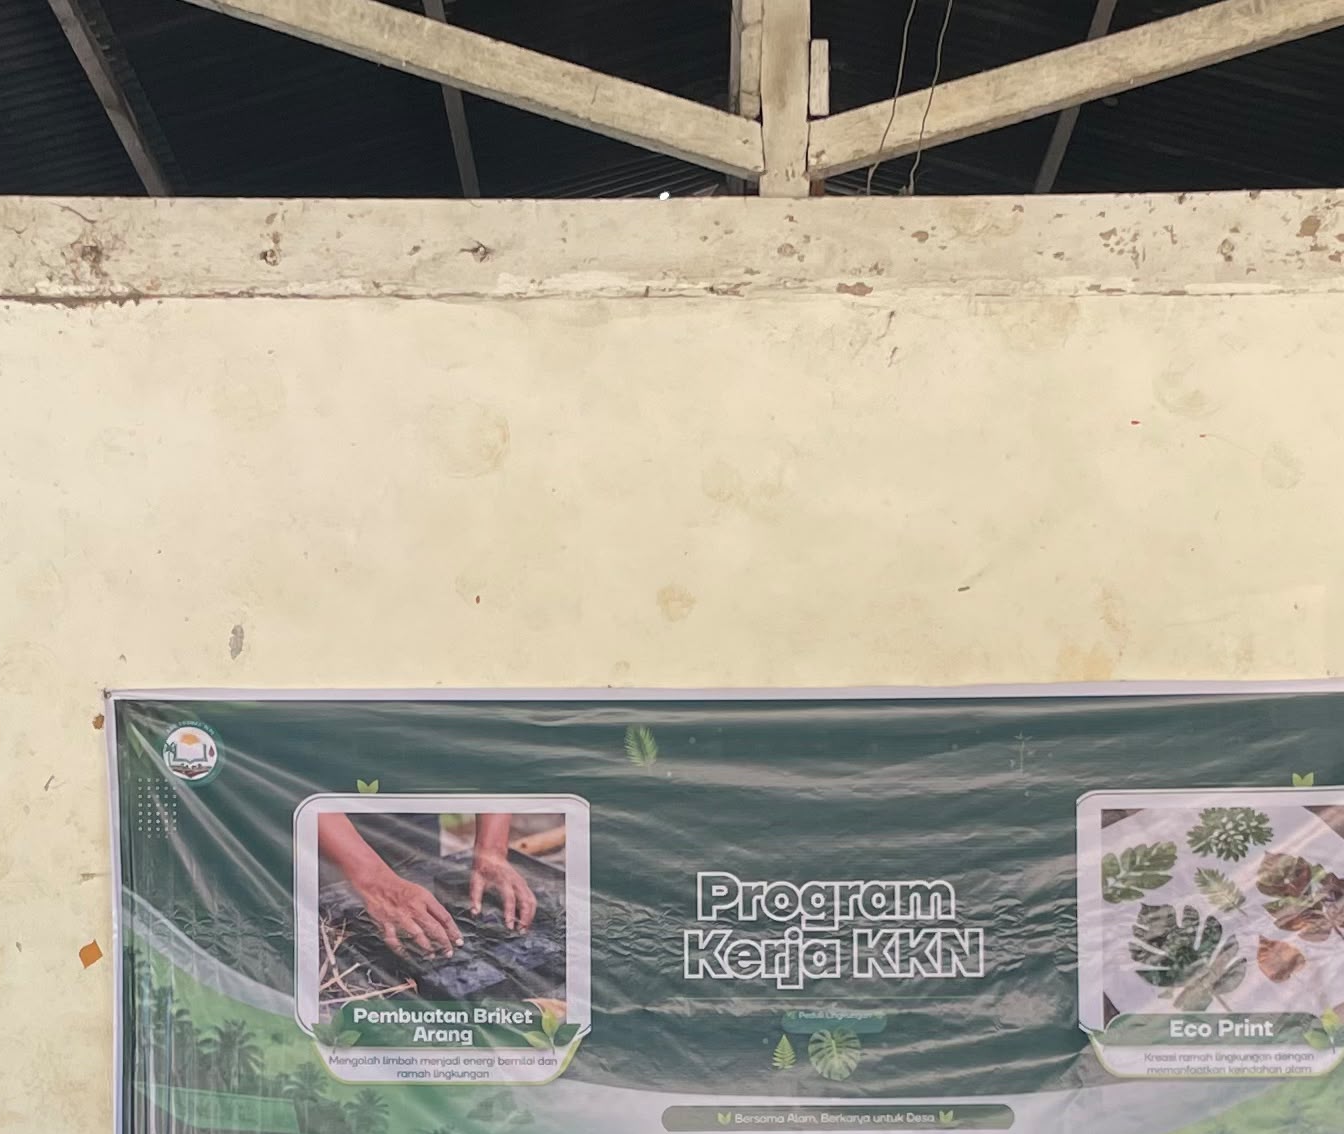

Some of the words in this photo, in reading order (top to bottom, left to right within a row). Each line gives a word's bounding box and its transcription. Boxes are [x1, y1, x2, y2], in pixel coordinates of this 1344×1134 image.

[696, 871, 956, 931] Program
[683, 926, 841, 989] Kerja
[852, 927, 984, 978] KKN
[353, 1007, 469, 1024] Pembuatan
[473, 1007, 533, 1024] Briket
[412, 1026, 473, 1045] Arang
[1169, 1019, 1212, 1037] Eco
[1218, 1018, 1274, 1037] Print
[328, 1055, 380, 1068] Mengolah
[382, 1055, 418, 1066] limbah
[419, 1055, 460, 1068] menjadi
[463, 1055, 495, 1068] energi
[537, 1055, 558, 1066] dan
[1144, 1053, 1177, 1063] Kreasi
[1178, 1053, 1213, 1063] ramah
[1215, 1052, 1272, 1065] lingkungan
[1274, 1053, 1314, 1064] dengan
[396, 1069, 431, 1079] ramah
[433, 1068, 489, 1081] lingkungan
[1284, 1065, 1312, 1074] alam
[734, 1112, 785, 1124] Bersama
[786, 1112, 818, 1125] Alam,
[820, 1112, 871, 1126] Berkarya
[872, 1111, 904, 1124] untuk
[906, 1112, 935, 1123] Desa
